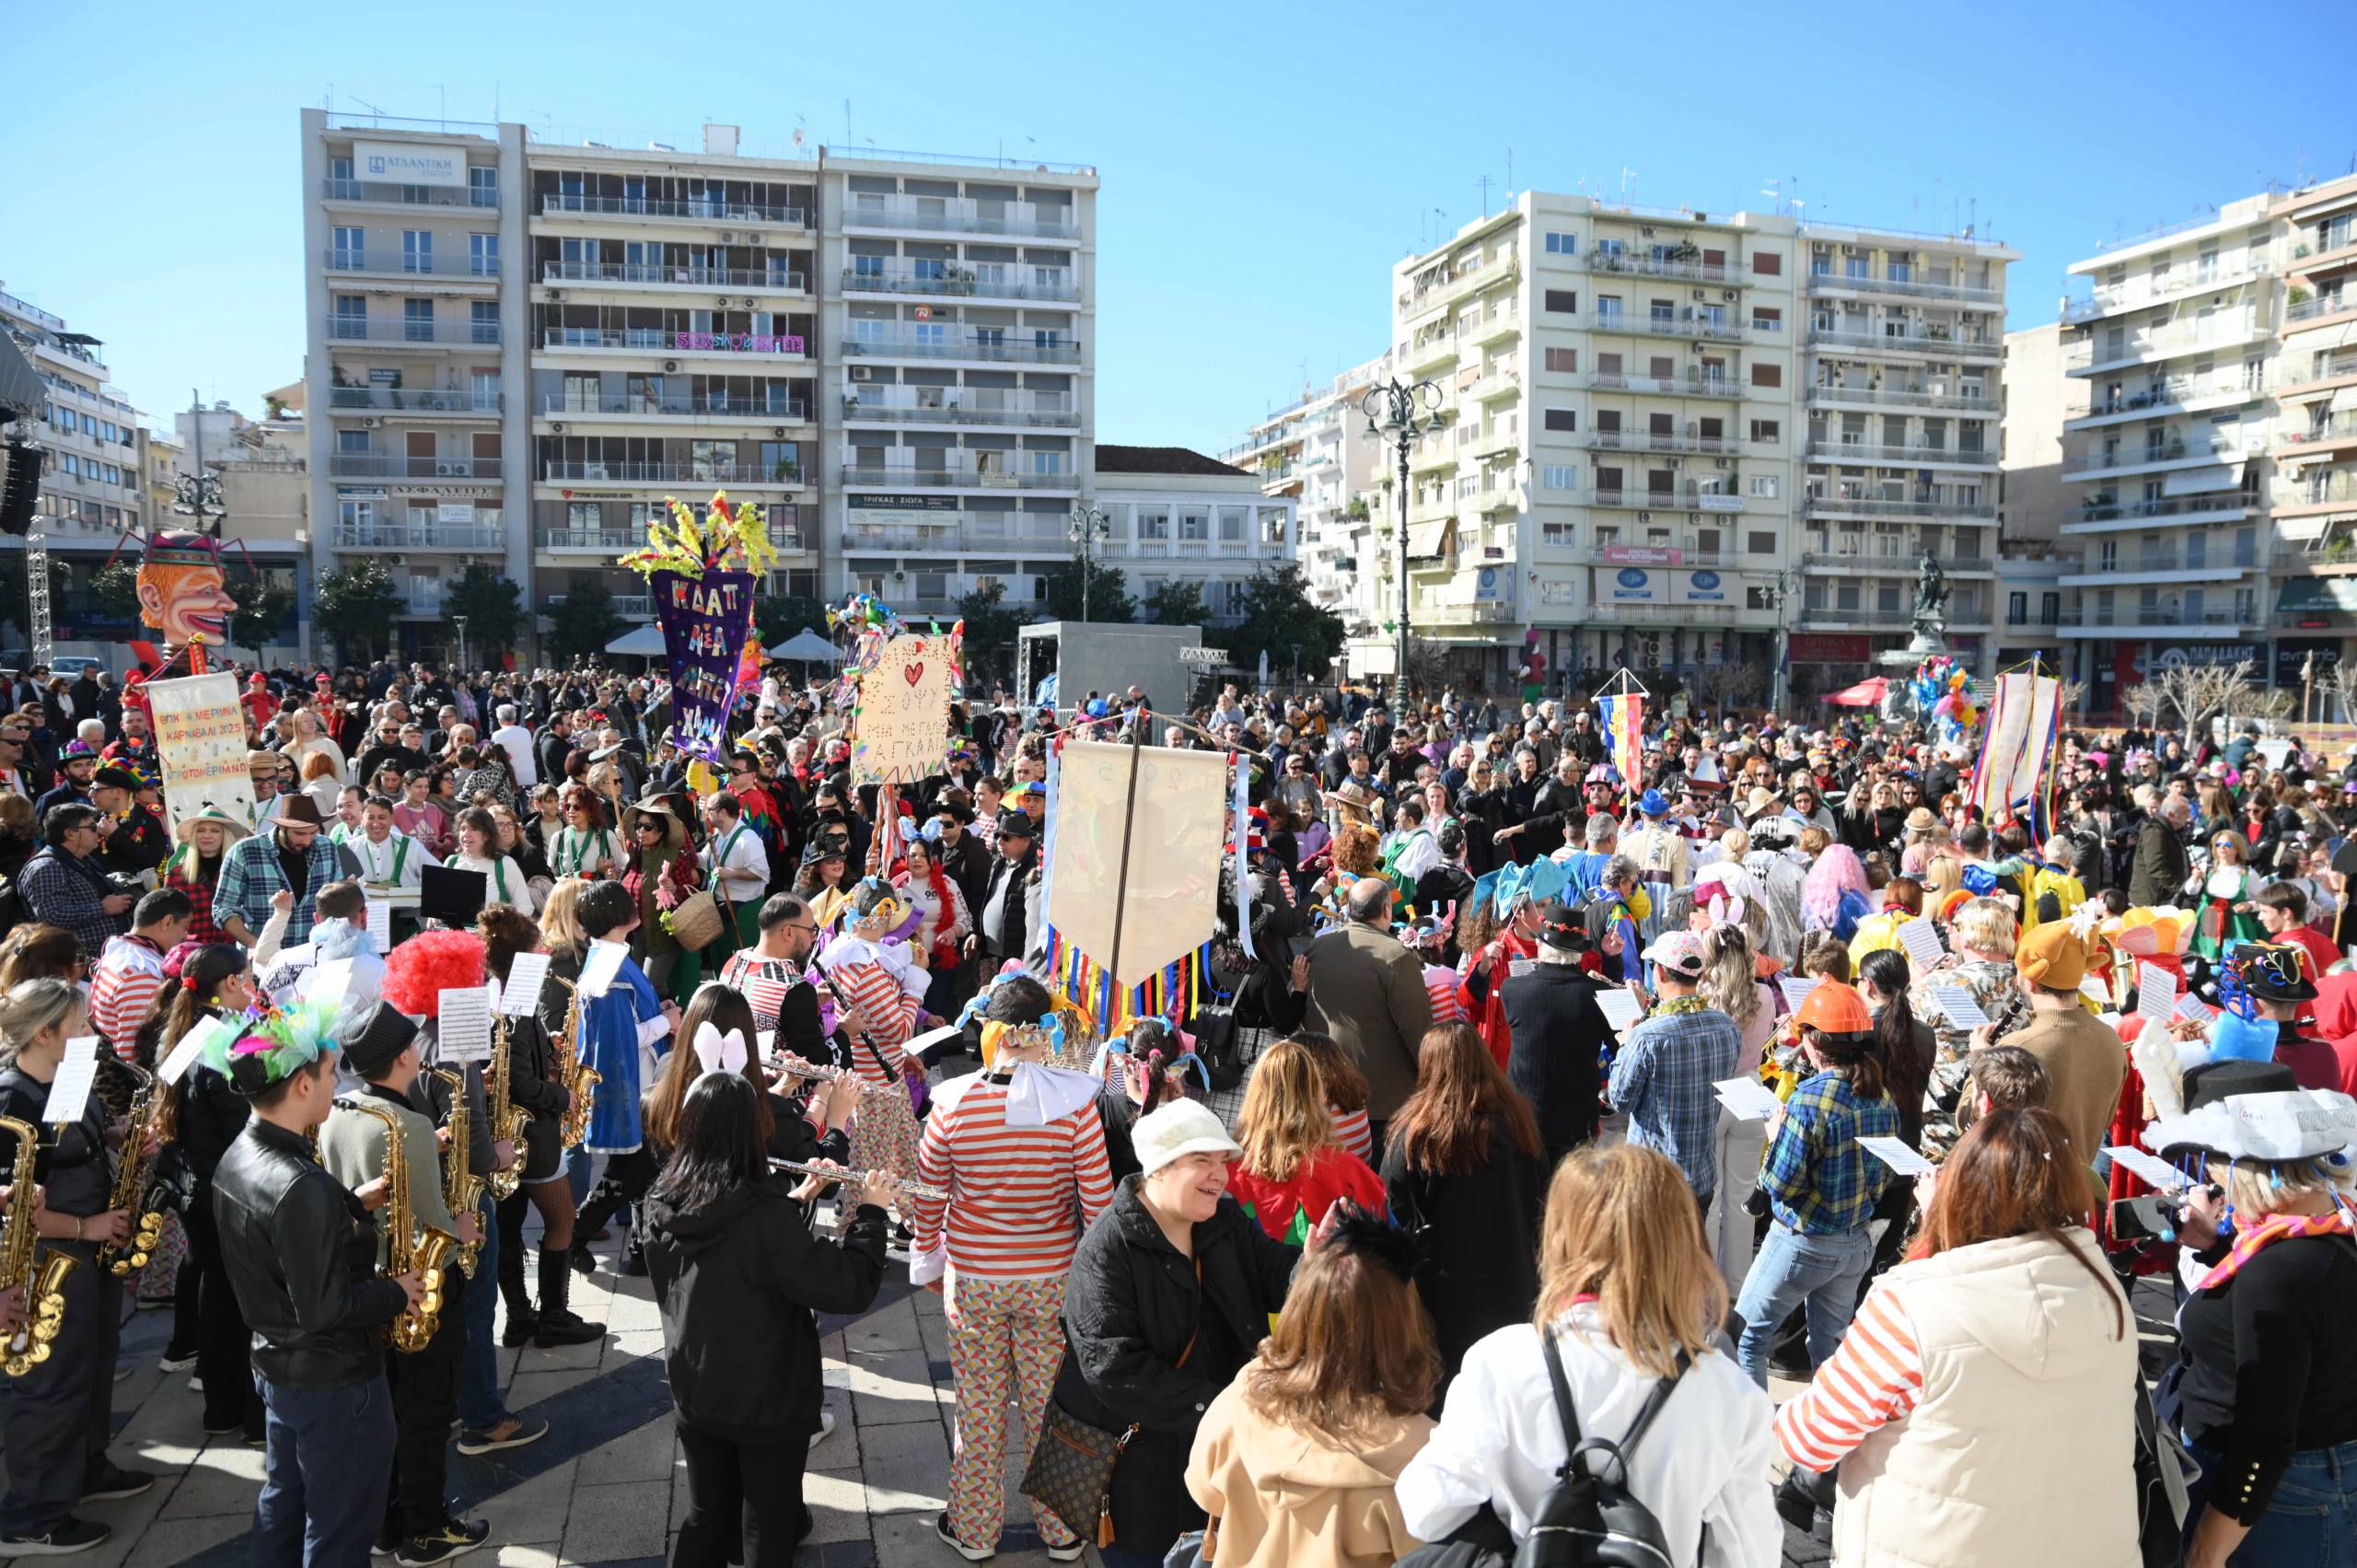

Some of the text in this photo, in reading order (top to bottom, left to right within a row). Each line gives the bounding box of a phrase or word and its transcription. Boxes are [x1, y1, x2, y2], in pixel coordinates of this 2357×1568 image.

[387, 156, 452, 170] ΑΤΛΑΝΤΙΚΗ
[677, 331, 713, 350] SEX
[394, 486, 492, 494] ΑΣΦΑΛΕΙΕΣ
[863, 495, 895, 504] ΤΡΙΓΚΑΣ
[670, 579, 739, 617] ΚΔΑΠ
[2189, 645, 2254, 661] ΠΑΠΑΔΑΚΗΣ
[195, 706, 238, 721] ΜΕΡΙΜΝΑ
[167, 723, 241, 741] ΚΑΡΝΑΒΑΛΙ 2025
